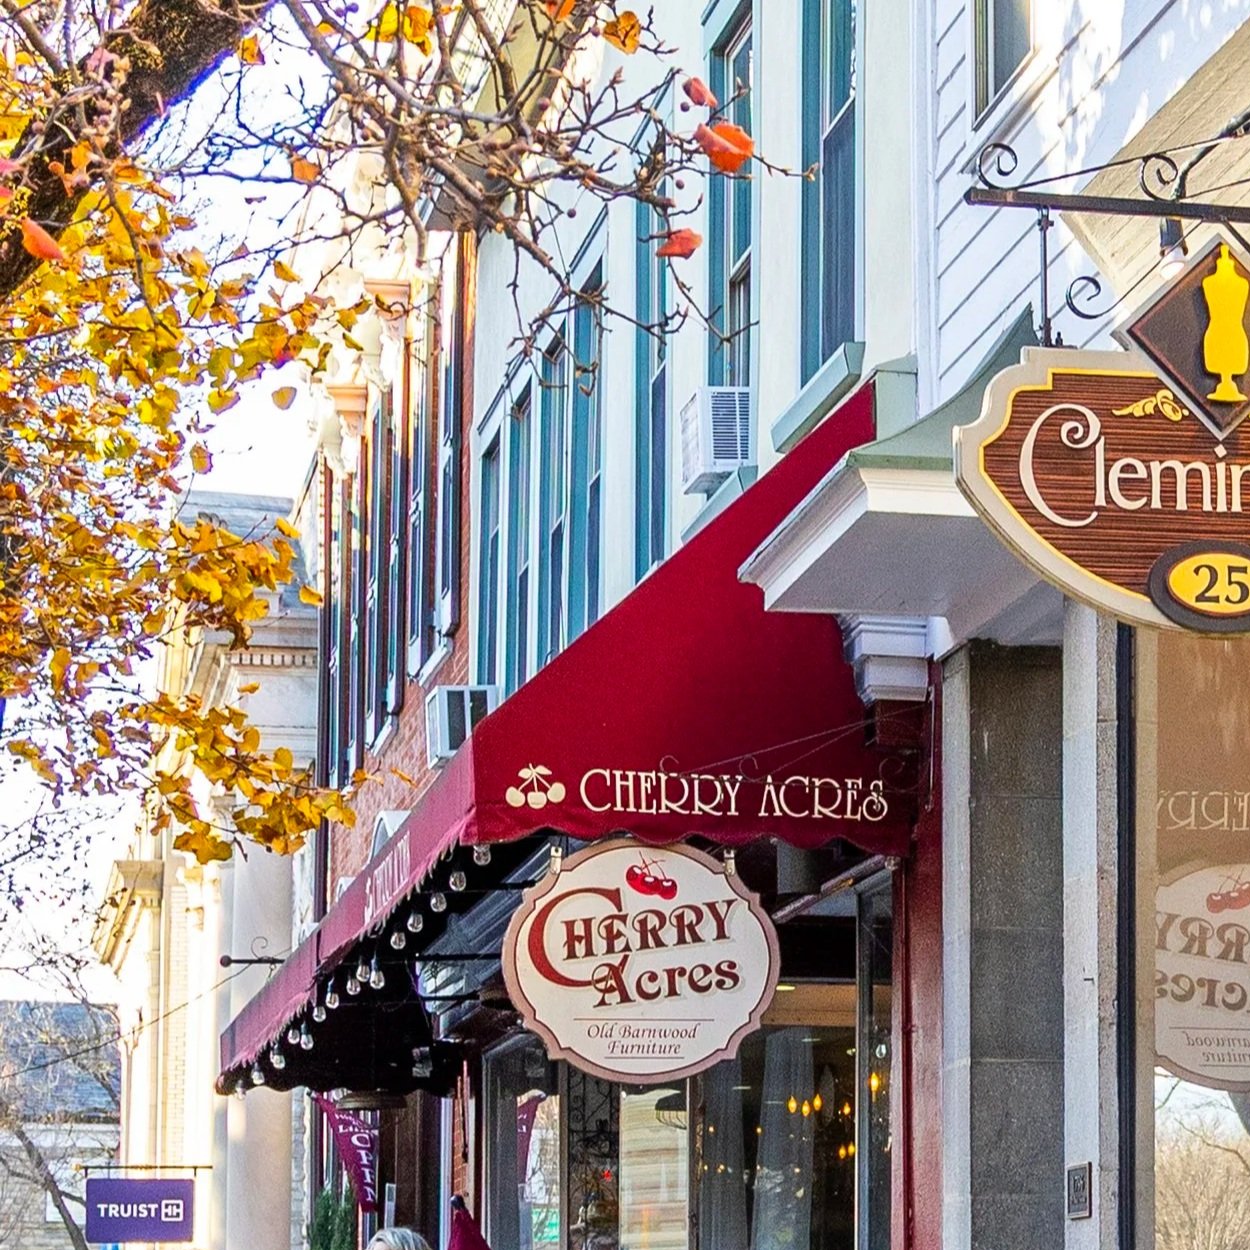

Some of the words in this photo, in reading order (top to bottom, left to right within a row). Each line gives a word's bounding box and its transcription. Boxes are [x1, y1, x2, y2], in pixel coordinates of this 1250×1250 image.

[1192, 563, 1250, 605] 25
[579, 767, 744, 817] CHERRY
[757, 773, 889, 822] ACRES
[528, 887, 739, 988] CHERRY
[590, 953, 741, 1009] Acres
[586, 1022, 616, 1041] Old
[617, 1022, 702, 1041] Barnwood
[605, 1039, 682, 1057] Furniture
[96, 1203, 159, 1218] TRUIST
